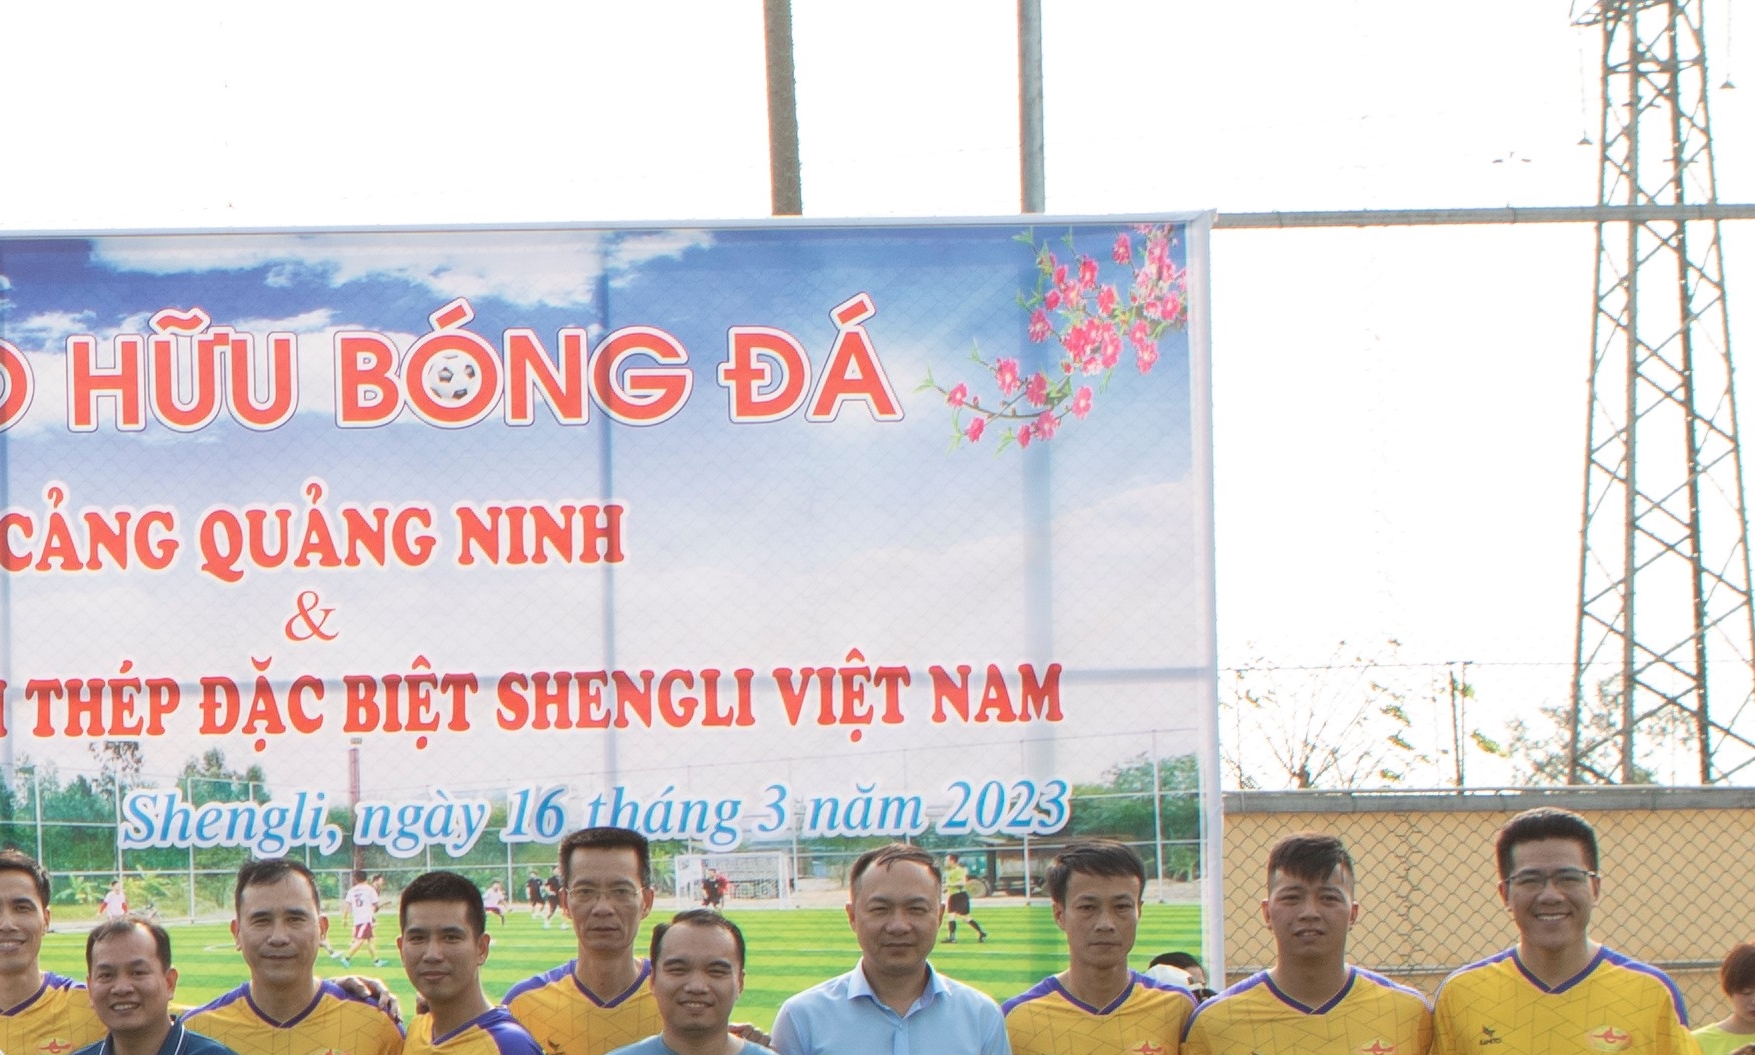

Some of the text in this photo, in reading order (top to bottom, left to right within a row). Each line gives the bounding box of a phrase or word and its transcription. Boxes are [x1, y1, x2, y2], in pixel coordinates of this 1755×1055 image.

[69, 309, 296, 431] HỮU
[336, 298, 692, 428] BÓNG
[721, 292, 903, 422] ĐÁ
[199, 482, 436, 580] QUẢNG
[457, 503, 625, 566] NINH
[286, 591, 339, 642] &
[26, 661, 181, 737] THÉP
[199, 657, 324, 751] ĐẶC
[343, 656, 477, 749] BIỆT
[496, 667, 755, 731] SHENGLI
[773, 648, 910, 742] VIỆT
[930, 664, 1063, 723] NAM
[123, 779, 1070, 854] Shengli, ngày 16 tháng 3 năm 2023
